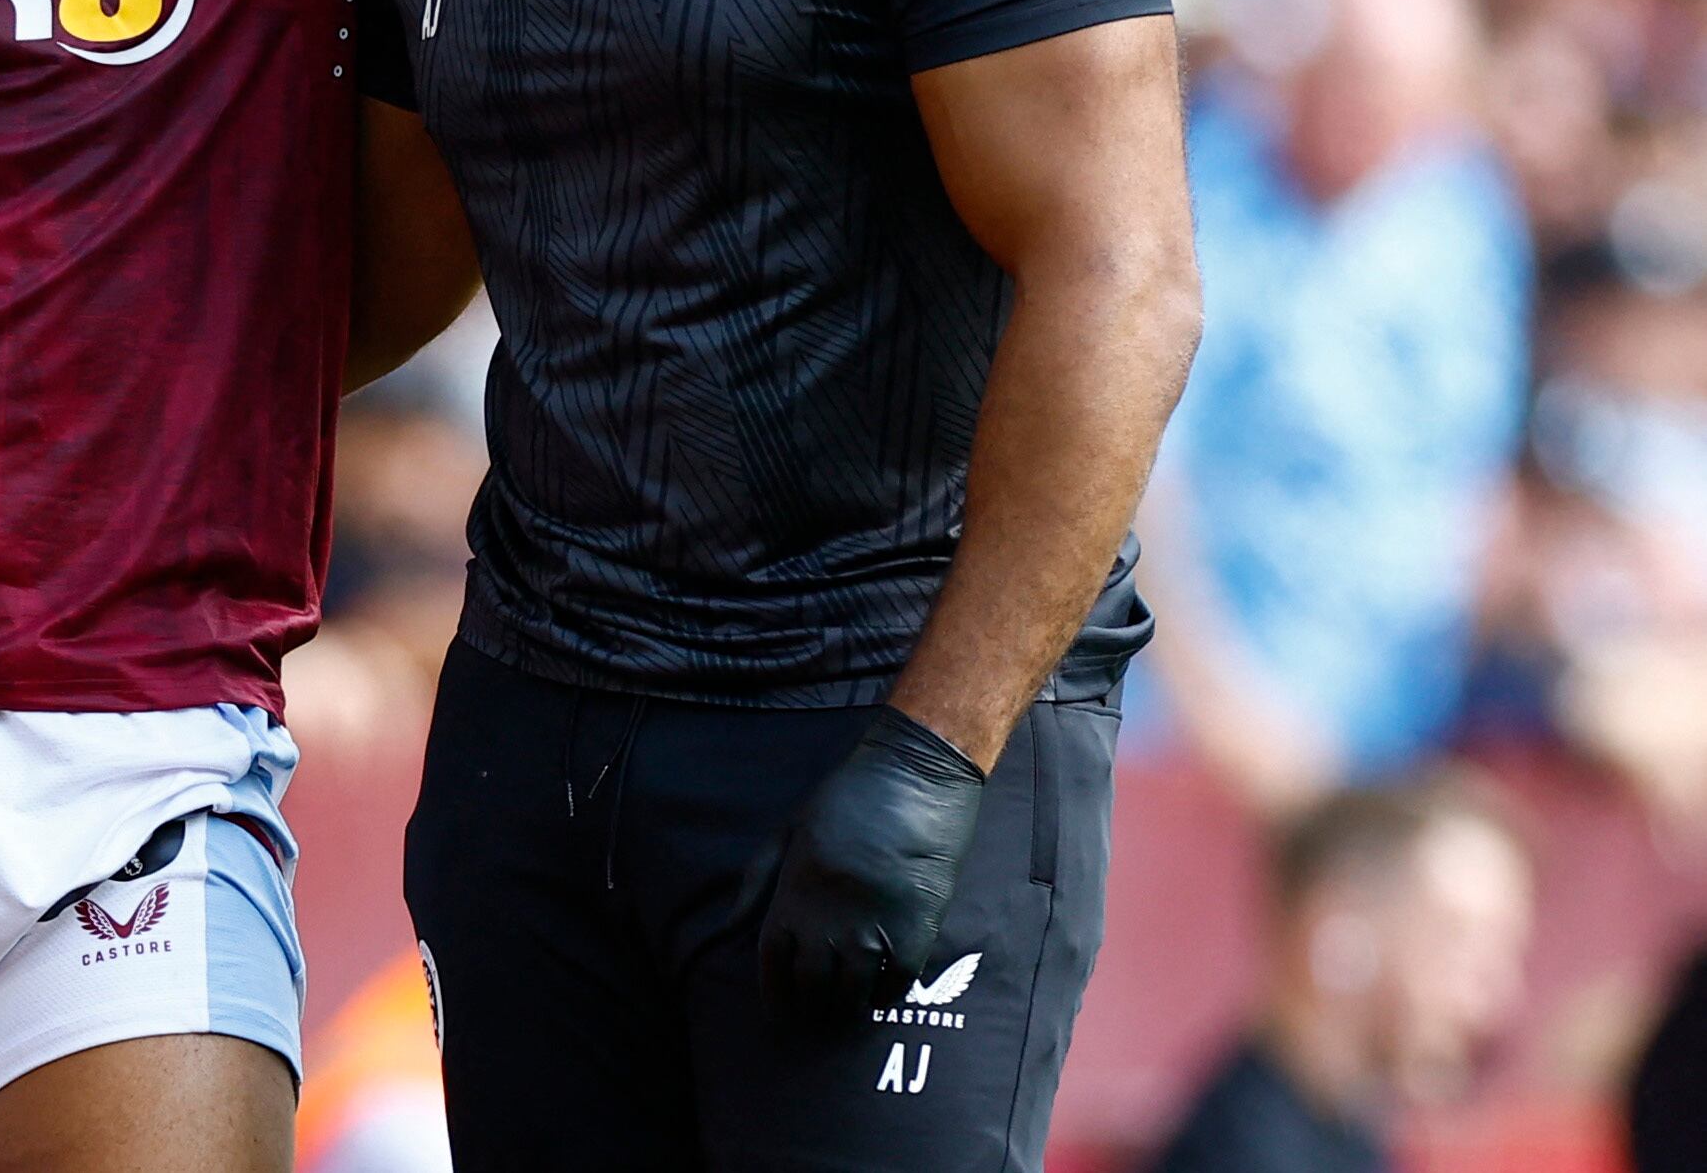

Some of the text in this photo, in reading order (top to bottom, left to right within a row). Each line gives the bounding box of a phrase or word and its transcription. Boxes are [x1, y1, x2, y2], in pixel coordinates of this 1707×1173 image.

[81, 940, 172, 966] CASTORE
[872, 1008, 965, 1029] CASTORE
[876, 1042, 932, 1093] AJ
